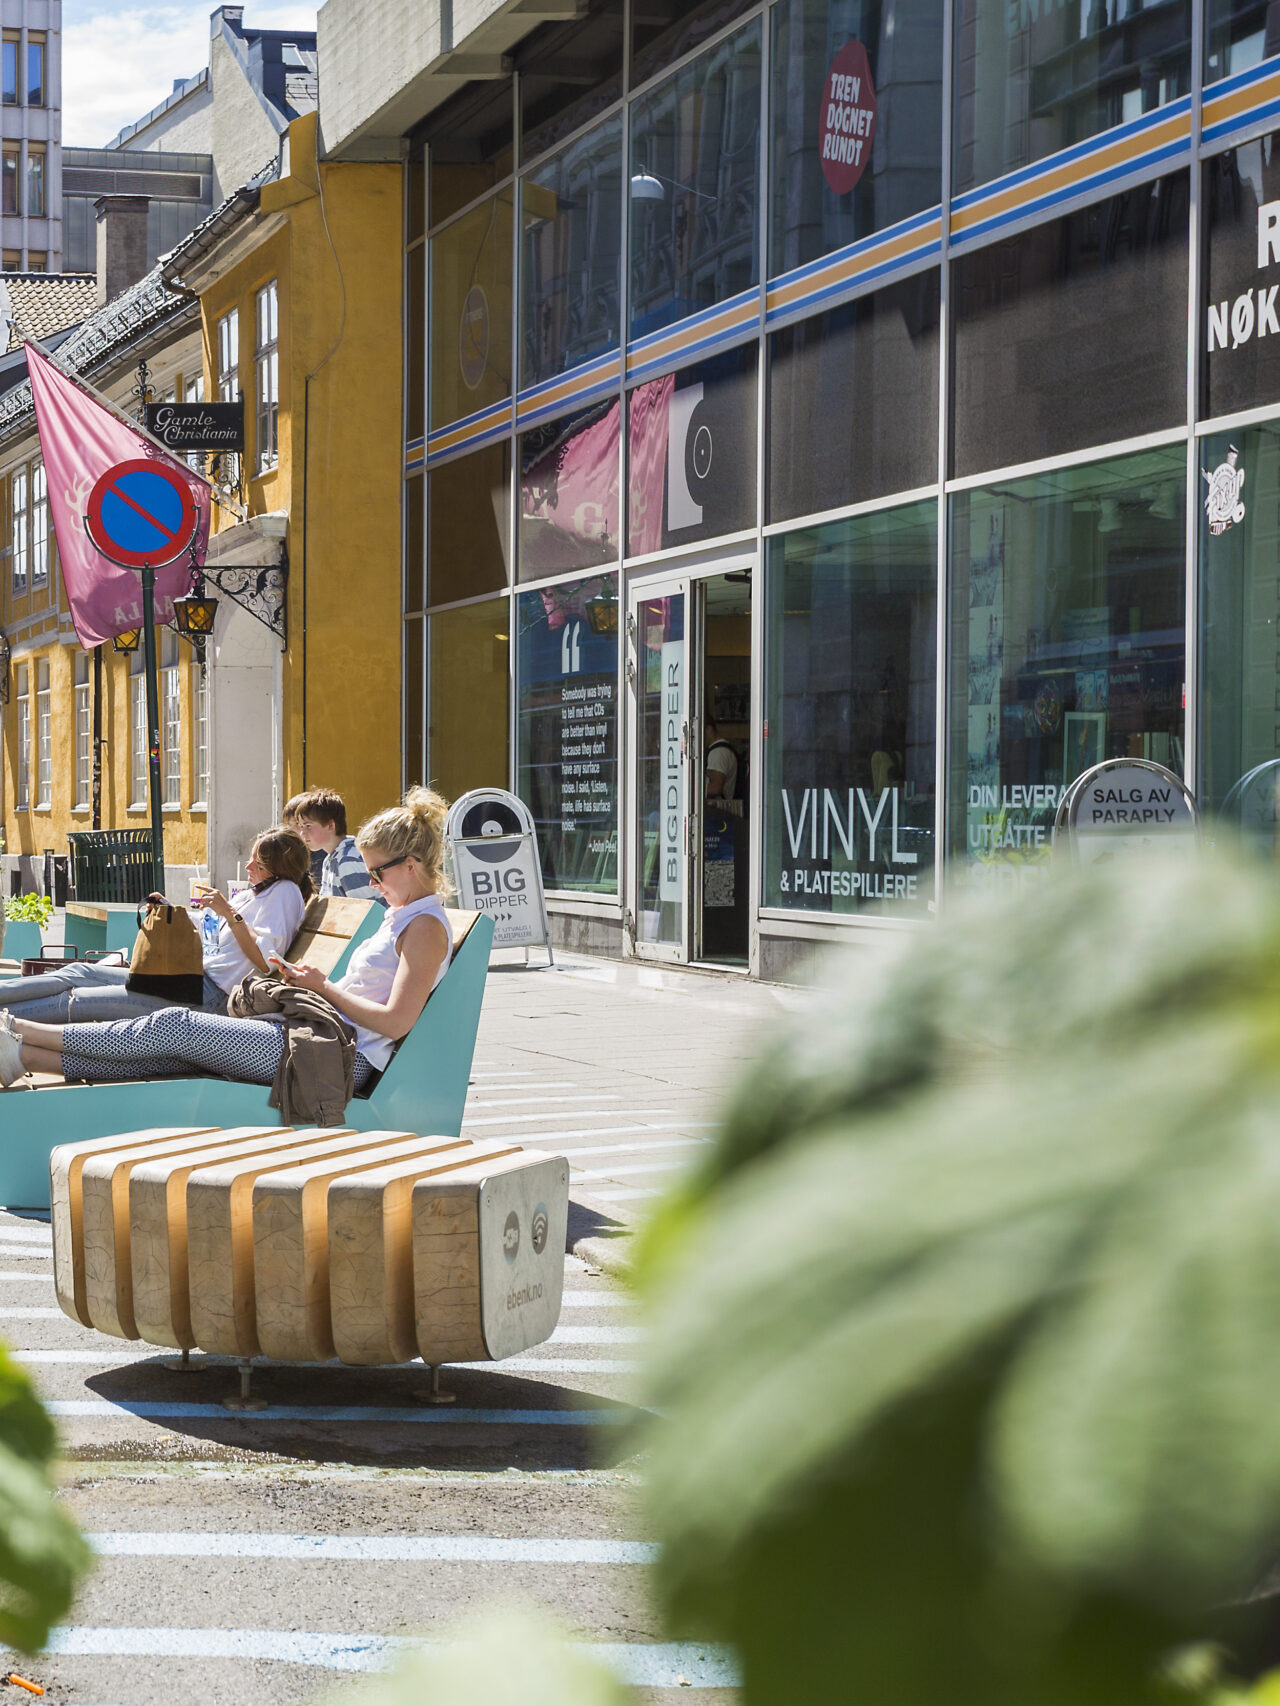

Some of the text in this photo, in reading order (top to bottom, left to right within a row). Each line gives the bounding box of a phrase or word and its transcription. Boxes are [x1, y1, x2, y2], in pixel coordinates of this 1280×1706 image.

[830, 73, 861, 104] TREN
[826, 102, 874, 138] DØGNET
[823, 133, 863, 167] RUNDT
[1207, 287, 1280, 353] NØK
[153, 407, 217, 432] Gamle
[163, 425, 238, 445] Christiania
[562, 683, 612, 701] Somebody was trying
[562, 702, 605, 719] to tell me that CDs
[562, 722, 608, 738] are better than vinyl
[562, 741, 606, 757] because they don't
[562, 761, 600, 777] have any surface
[562, 780, 576, 793] noise.
[579, 780, 590, 795] said,
[970, 784, 999, 808] DIN
[1093, 788, 1172, 804] SALG AV
[562, 801, 575, 814] mate,
[583, 799, 593, 812] has
[593, 800, 611, 812] surface
[1092, 808, 1176, 824] PARAPLY
[781, 787, 918, 864] VINYL
[969, 818, 1046, 849] UTGÅTTE
[605, 839, 617, 853] Peel
[471, 867, 526, 895] BIG
[780, 869, 918, 900] & PLATESPILLERE
[474, 894, 528, 910] DIPPER
[506, 1283, 543, 1311] ebenk.no
